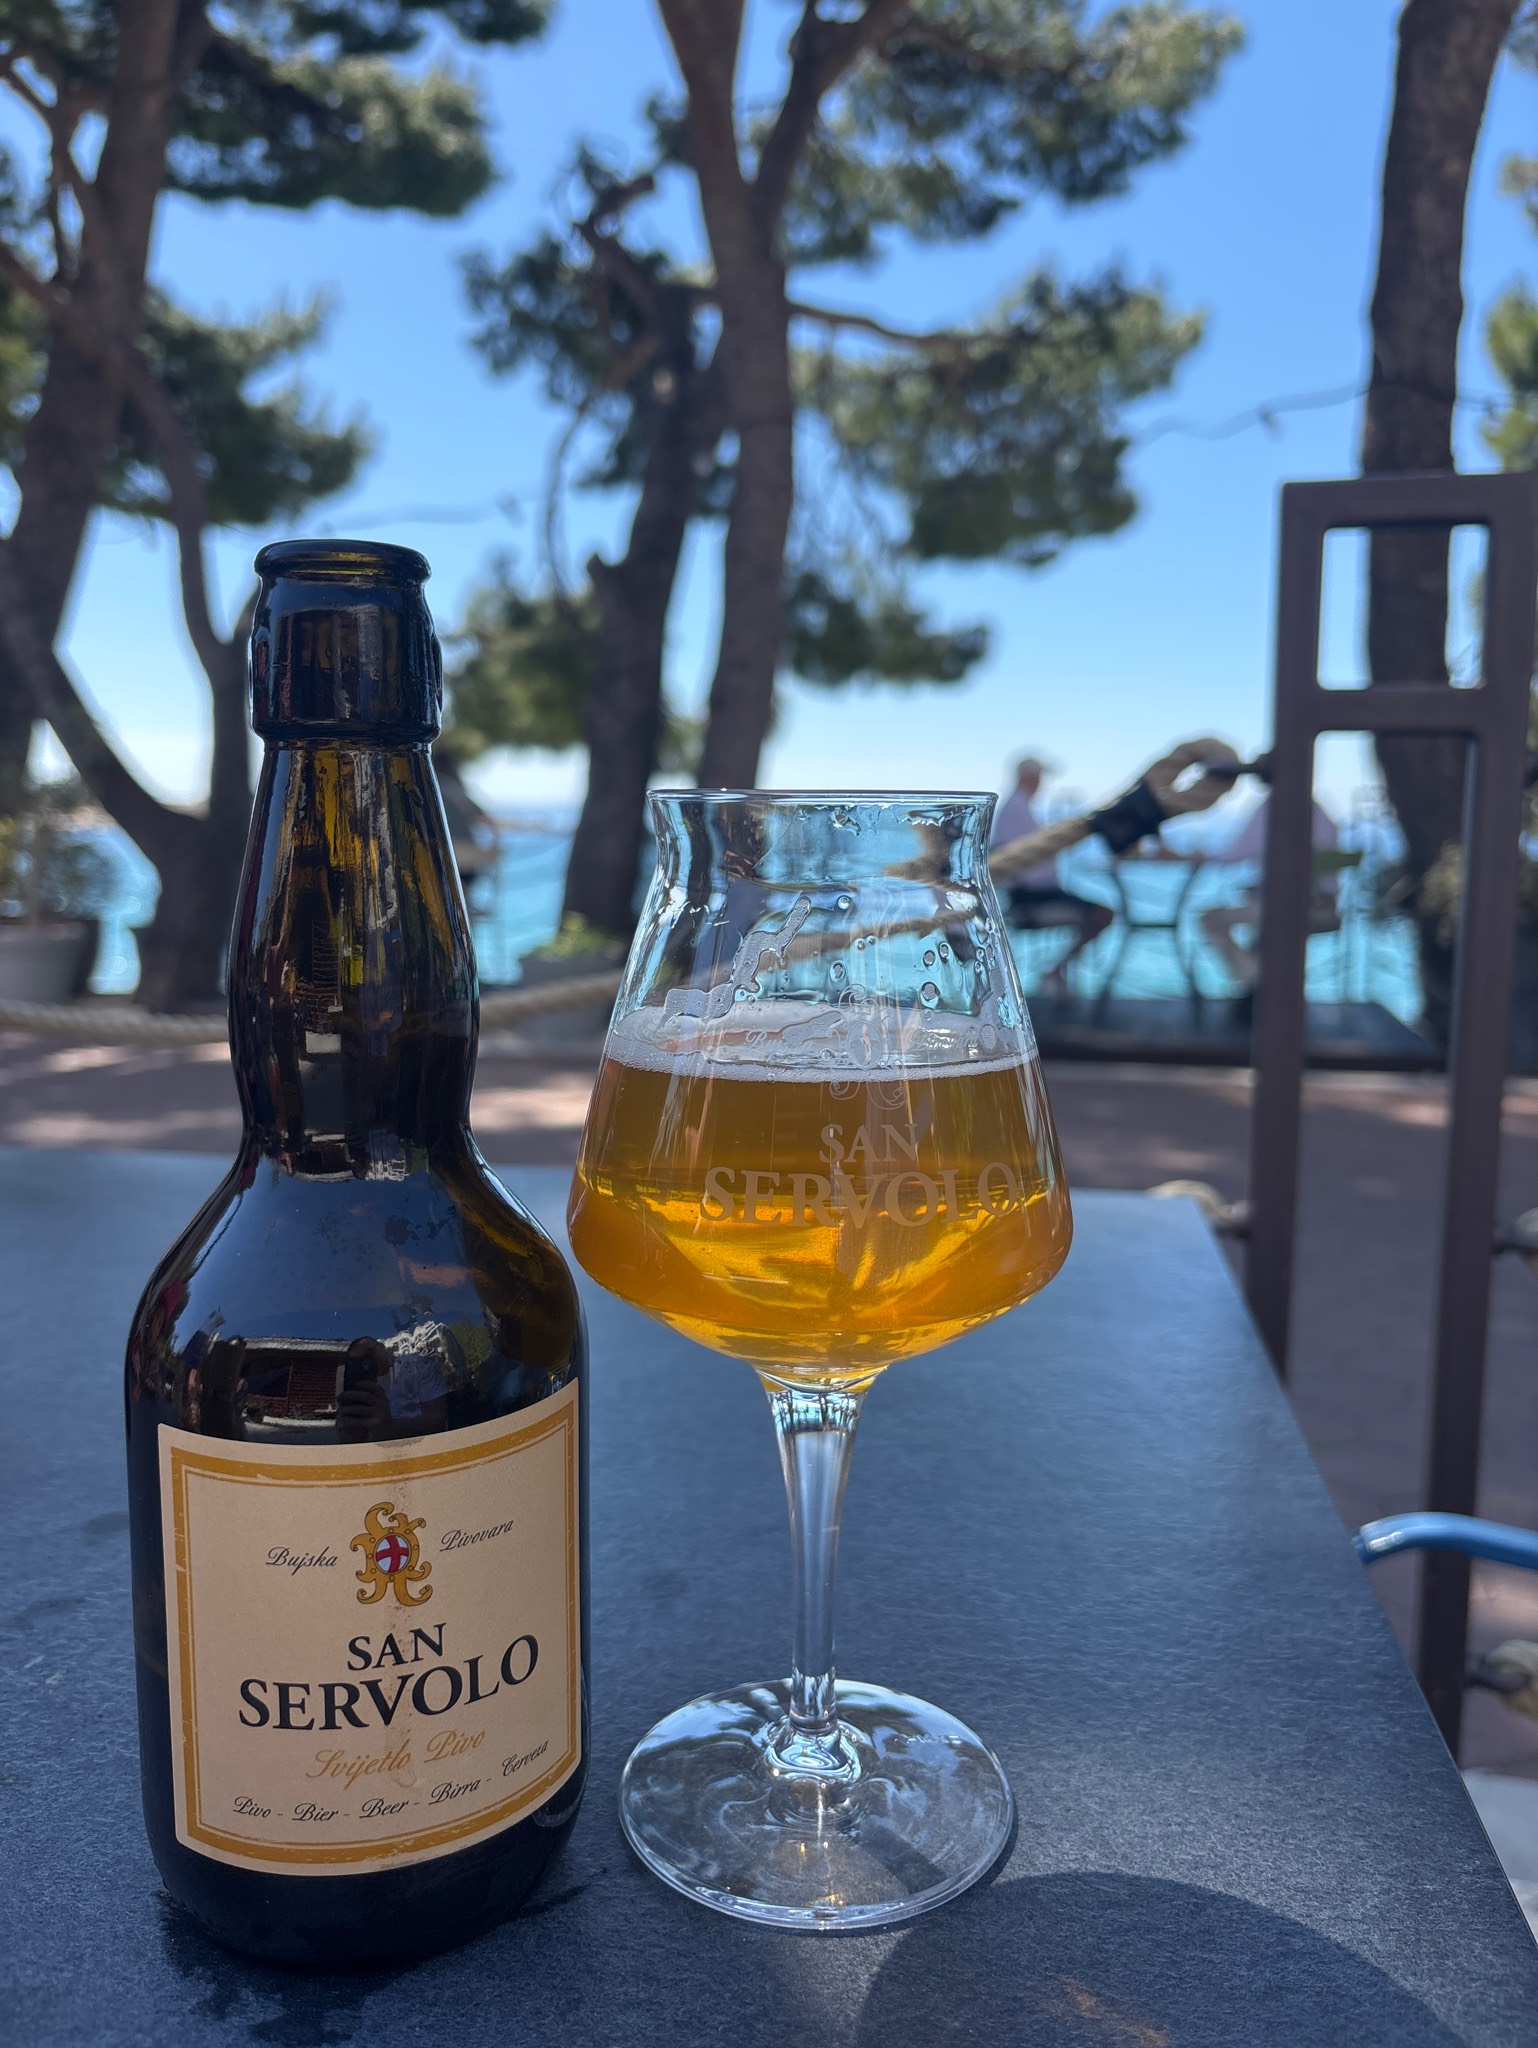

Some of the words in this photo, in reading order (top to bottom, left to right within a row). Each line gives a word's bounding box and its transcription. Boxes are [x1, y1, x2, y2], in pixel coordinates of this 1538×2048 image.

[819, 1122, 918, 1164] SAN
[700, 1161, 1018, 1229] SERVOLO
[265, 1546, 339, 1576] Bujska
[439, 1519, 515, 1552] Pivovara
[347, 1622, 447, 1671] SAN
[238, 1634, 540, 1731] SERVOLO
[232, 1796, 272, 1818] Pivo
[291, 1802, 339, 1822] Bier
[358, 1797, 410, 1819] Beer
[428, 1777, 482, 1806] Birra
[501, 1740, 550, 1777] Cerveza
[305, 1738, 412, 1790] Svijetlo
[423, 1728, 486, 1763] Pivo
